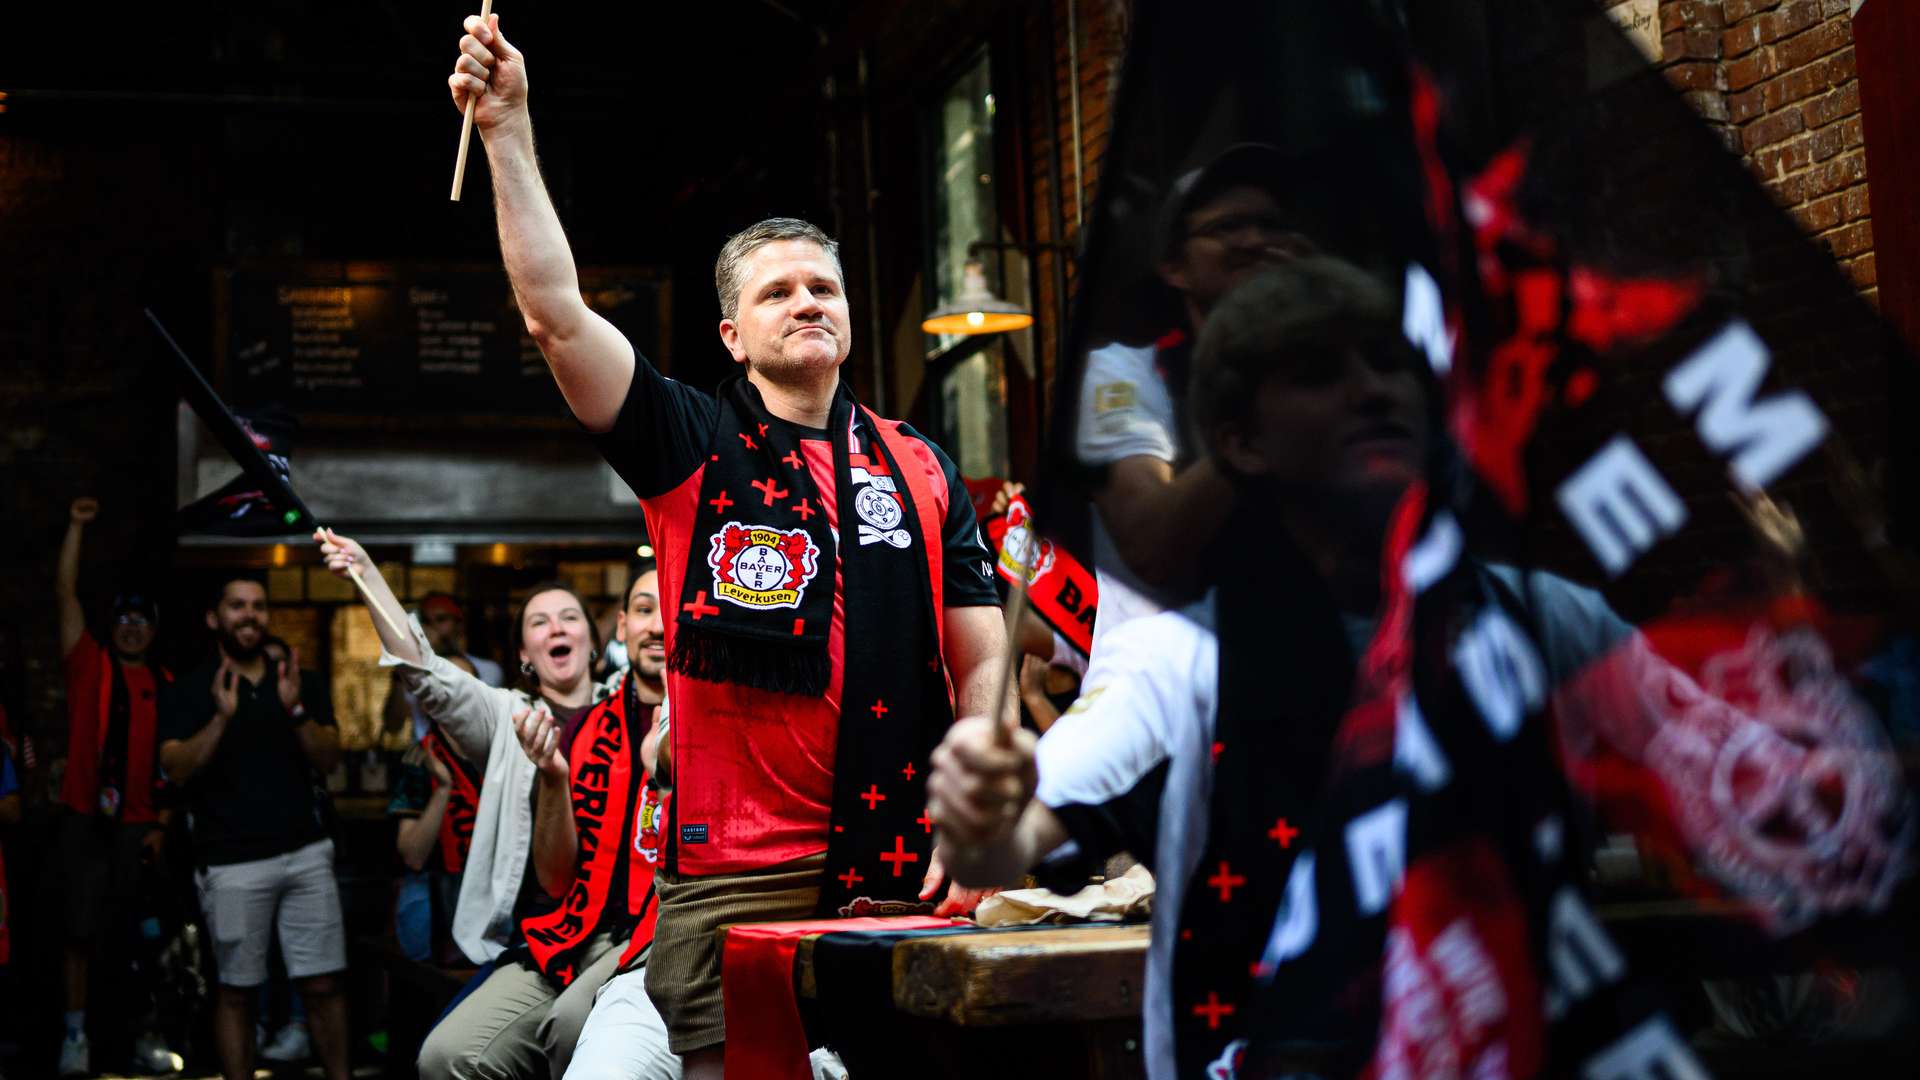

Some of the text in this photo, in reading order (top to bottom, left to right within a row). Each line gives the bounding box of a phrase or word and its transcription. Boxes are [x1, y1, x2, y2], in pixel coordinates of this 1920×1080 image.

[752, 533, 777, 544] 1904
[740, 562, 782, 574] BAYER
[754, 548, 768, 588] BAYER
[723, 585, 791, 603] Leverkusen
